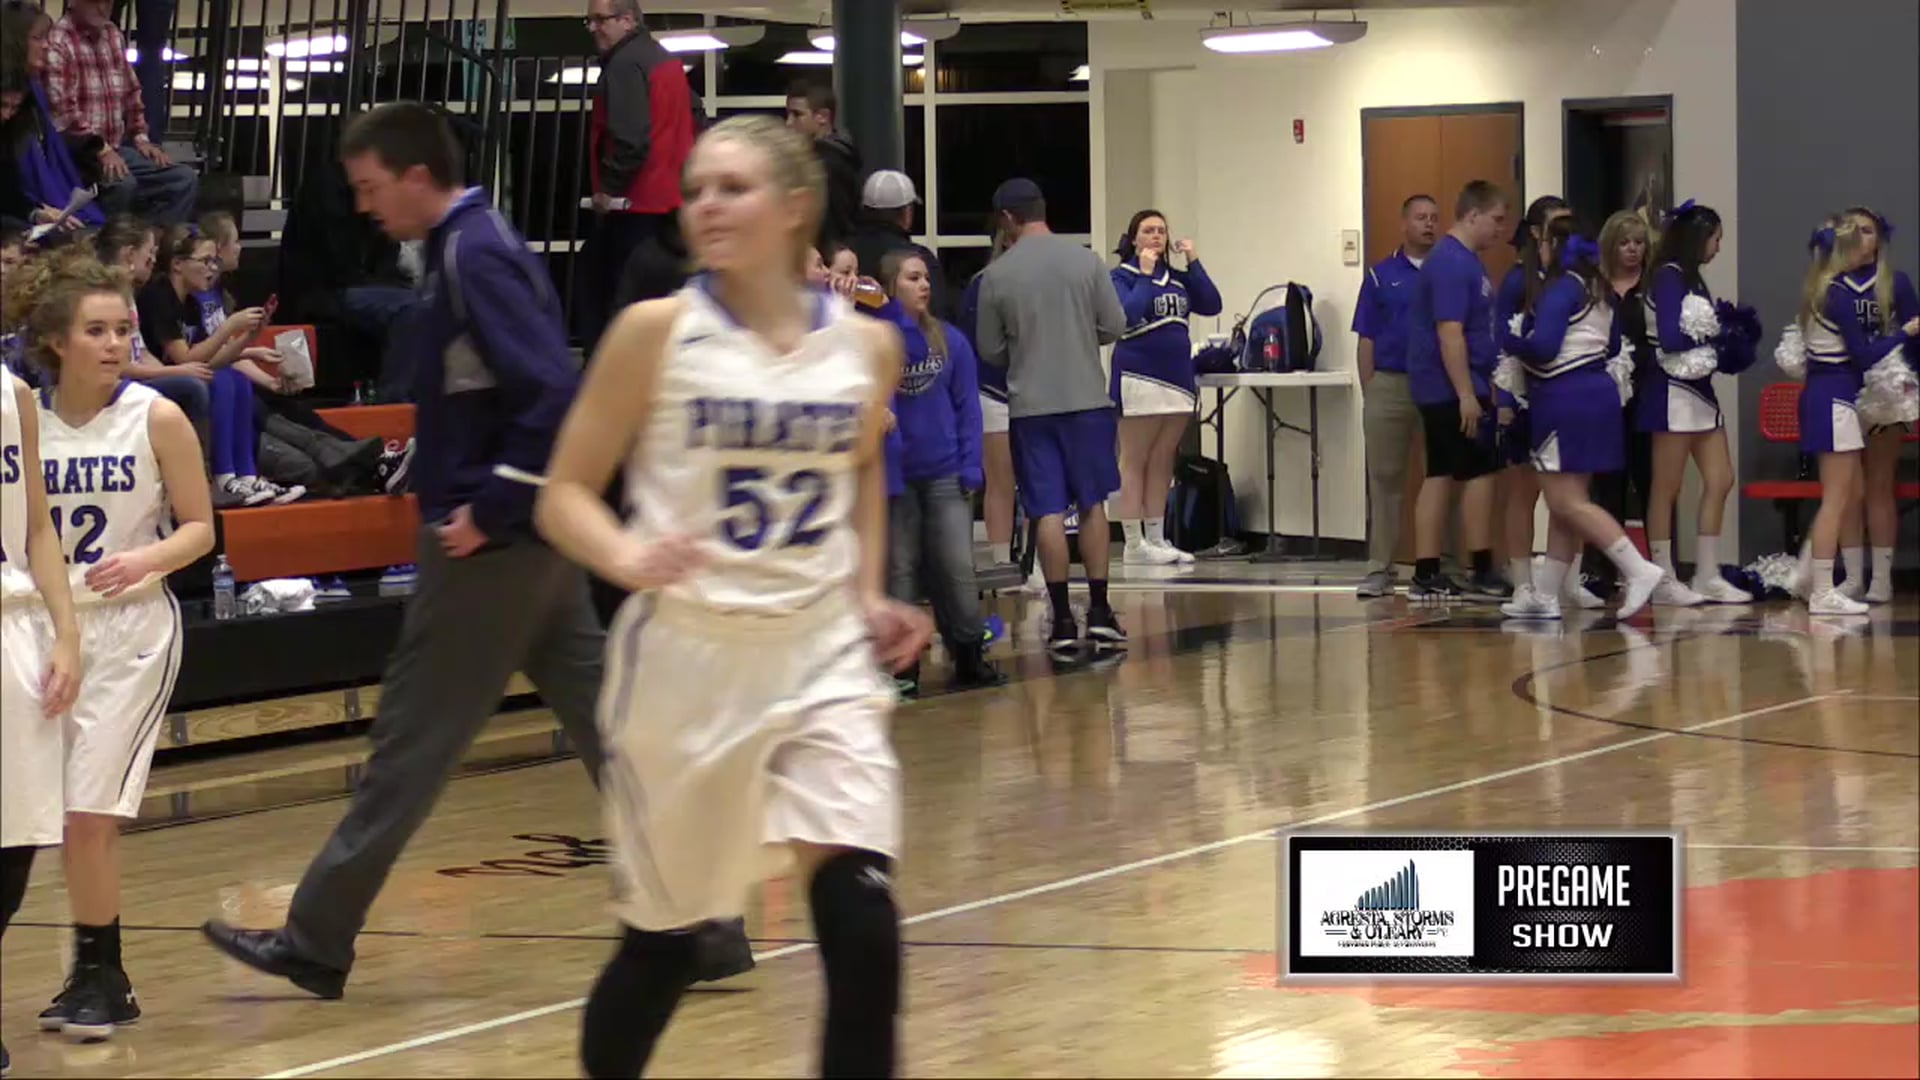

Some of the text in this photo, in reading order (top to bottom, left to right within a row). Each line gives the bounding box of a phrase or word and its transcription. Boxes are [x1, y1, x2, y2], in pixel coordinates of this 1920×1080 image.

[686, 398, 862, 453] PIRATE
[42, 455, 136, 495] RATES
[720, 466, 828, 551] 52
